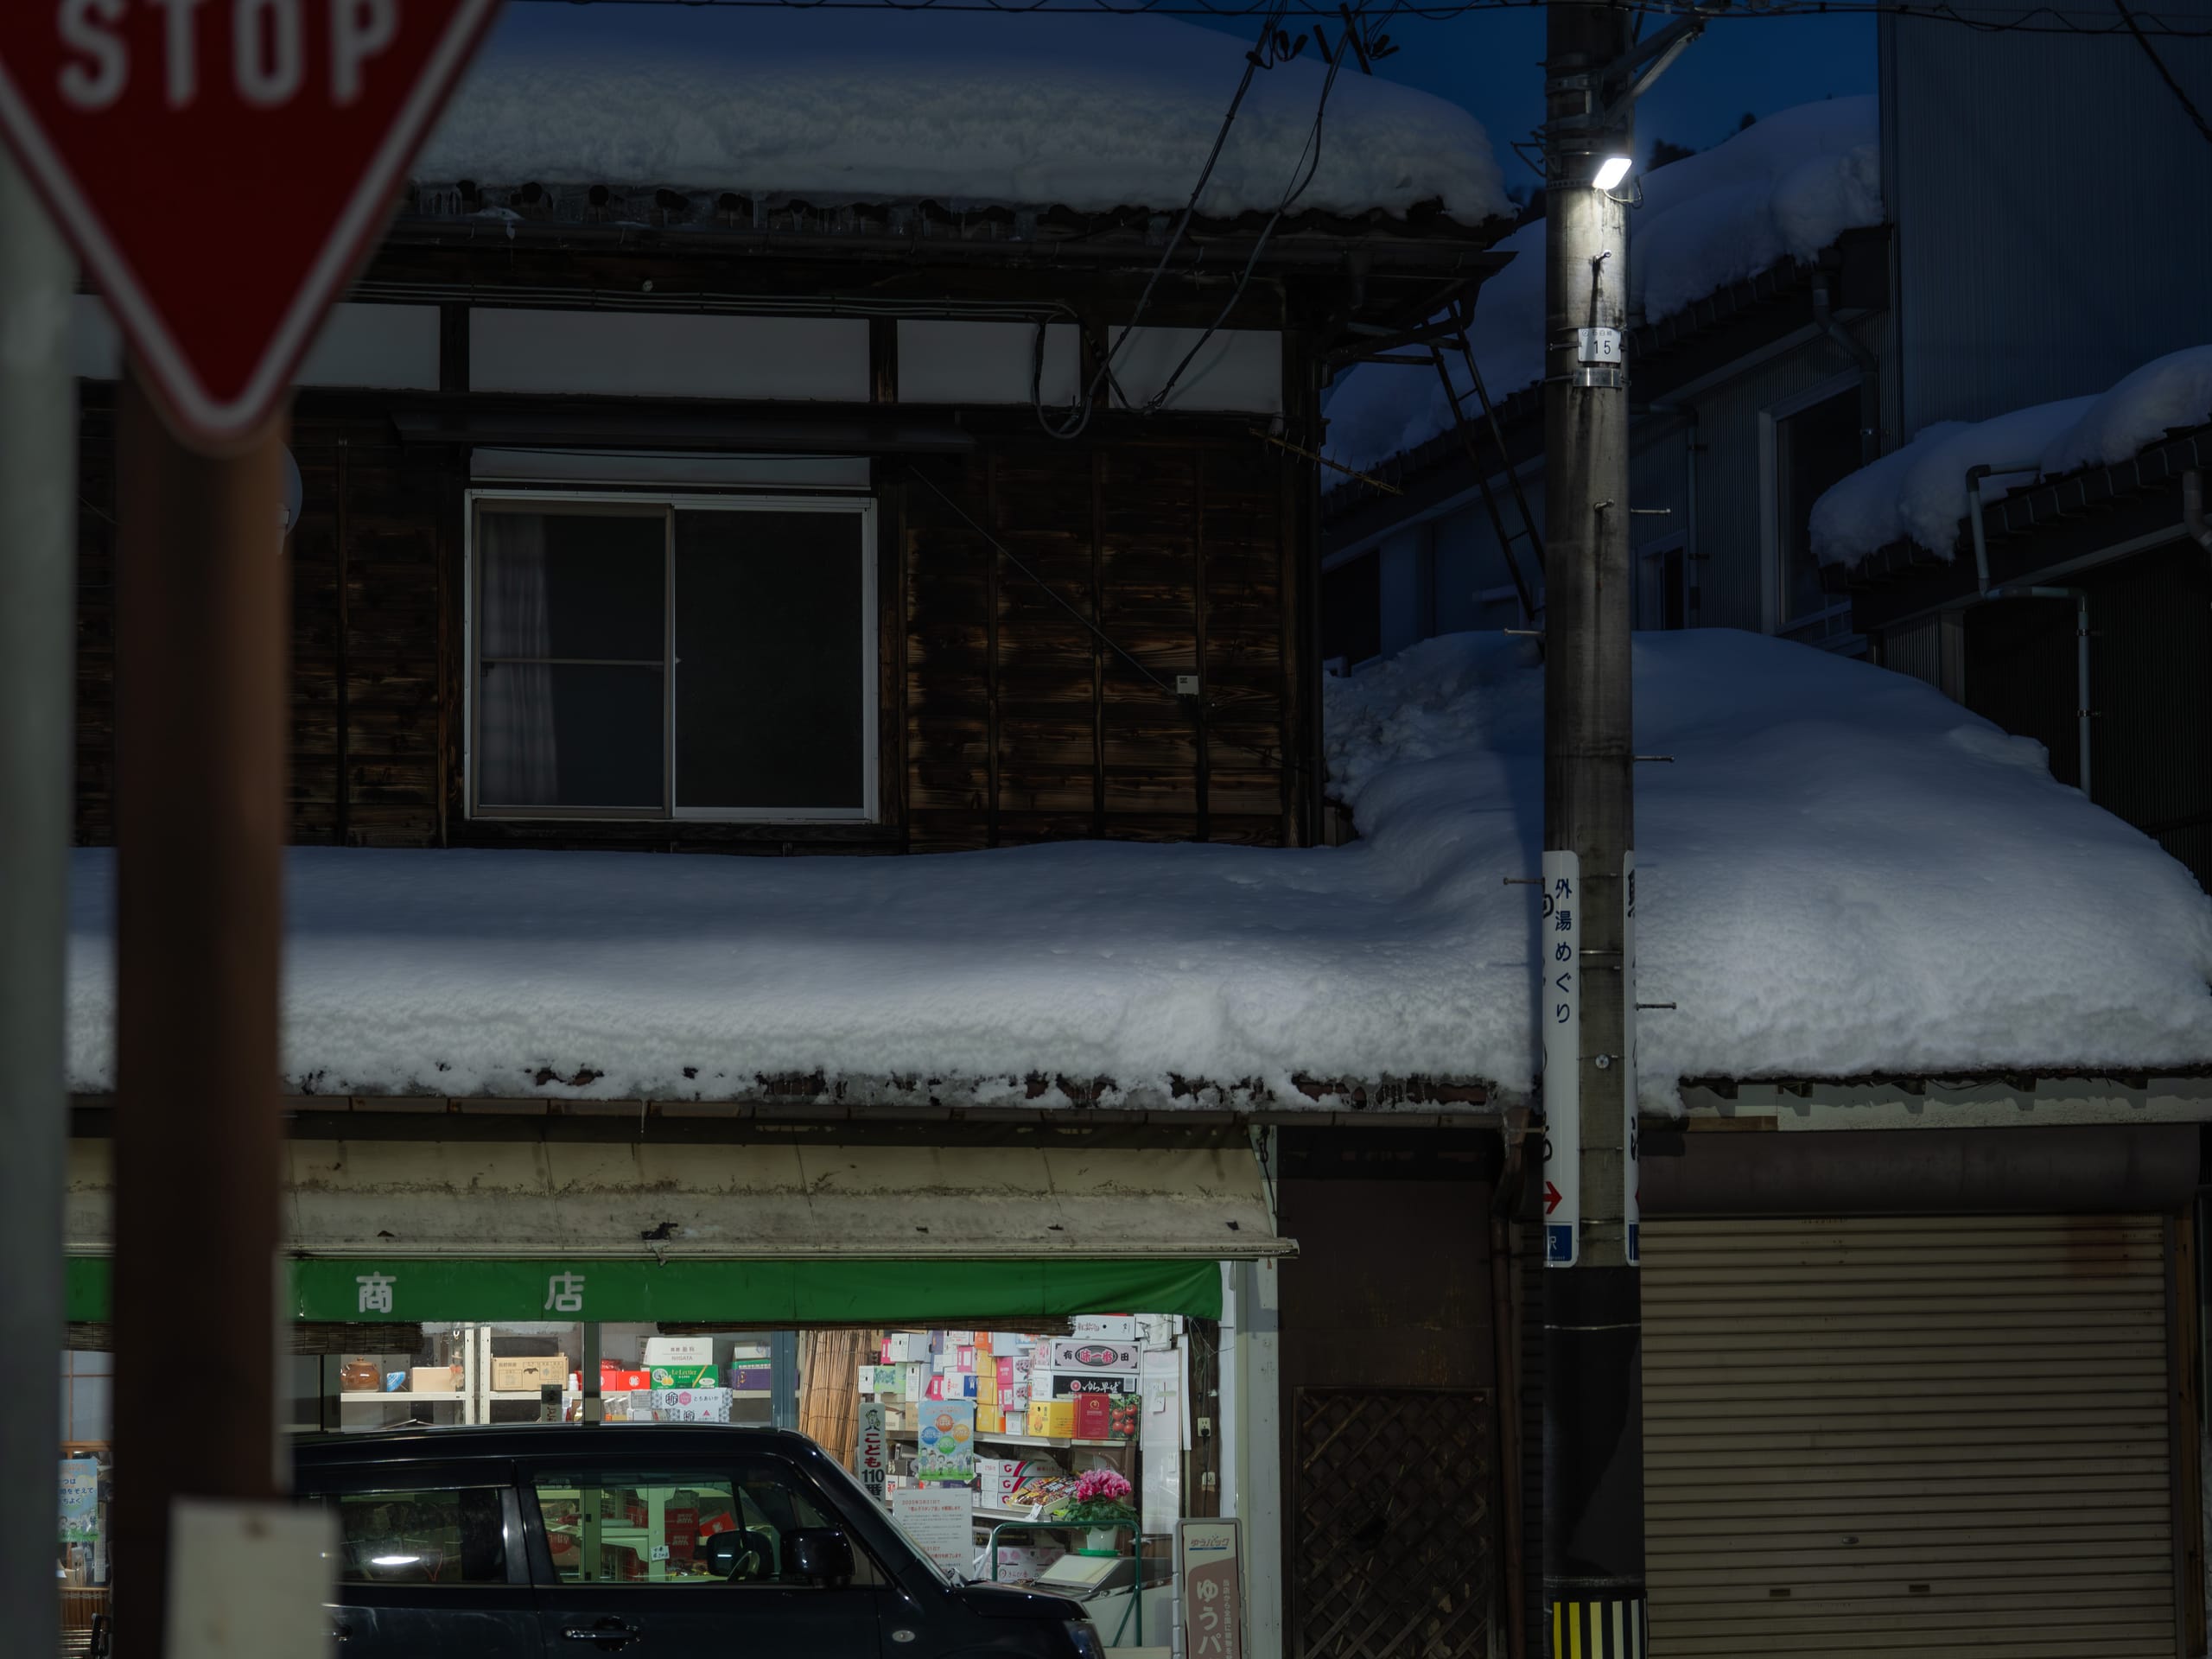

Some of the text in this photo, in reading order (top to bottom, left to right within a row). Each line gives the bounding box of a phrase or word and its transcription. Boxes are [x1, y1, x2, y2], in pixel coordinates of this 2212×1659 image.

[55, 0, 403, 111] STOP
[1593, 340, 1611, 354] 15
[1554, 879, 1573, 1024] 外湯めぐり
[1197, 1579, 1222, 1659] ゆうパ
